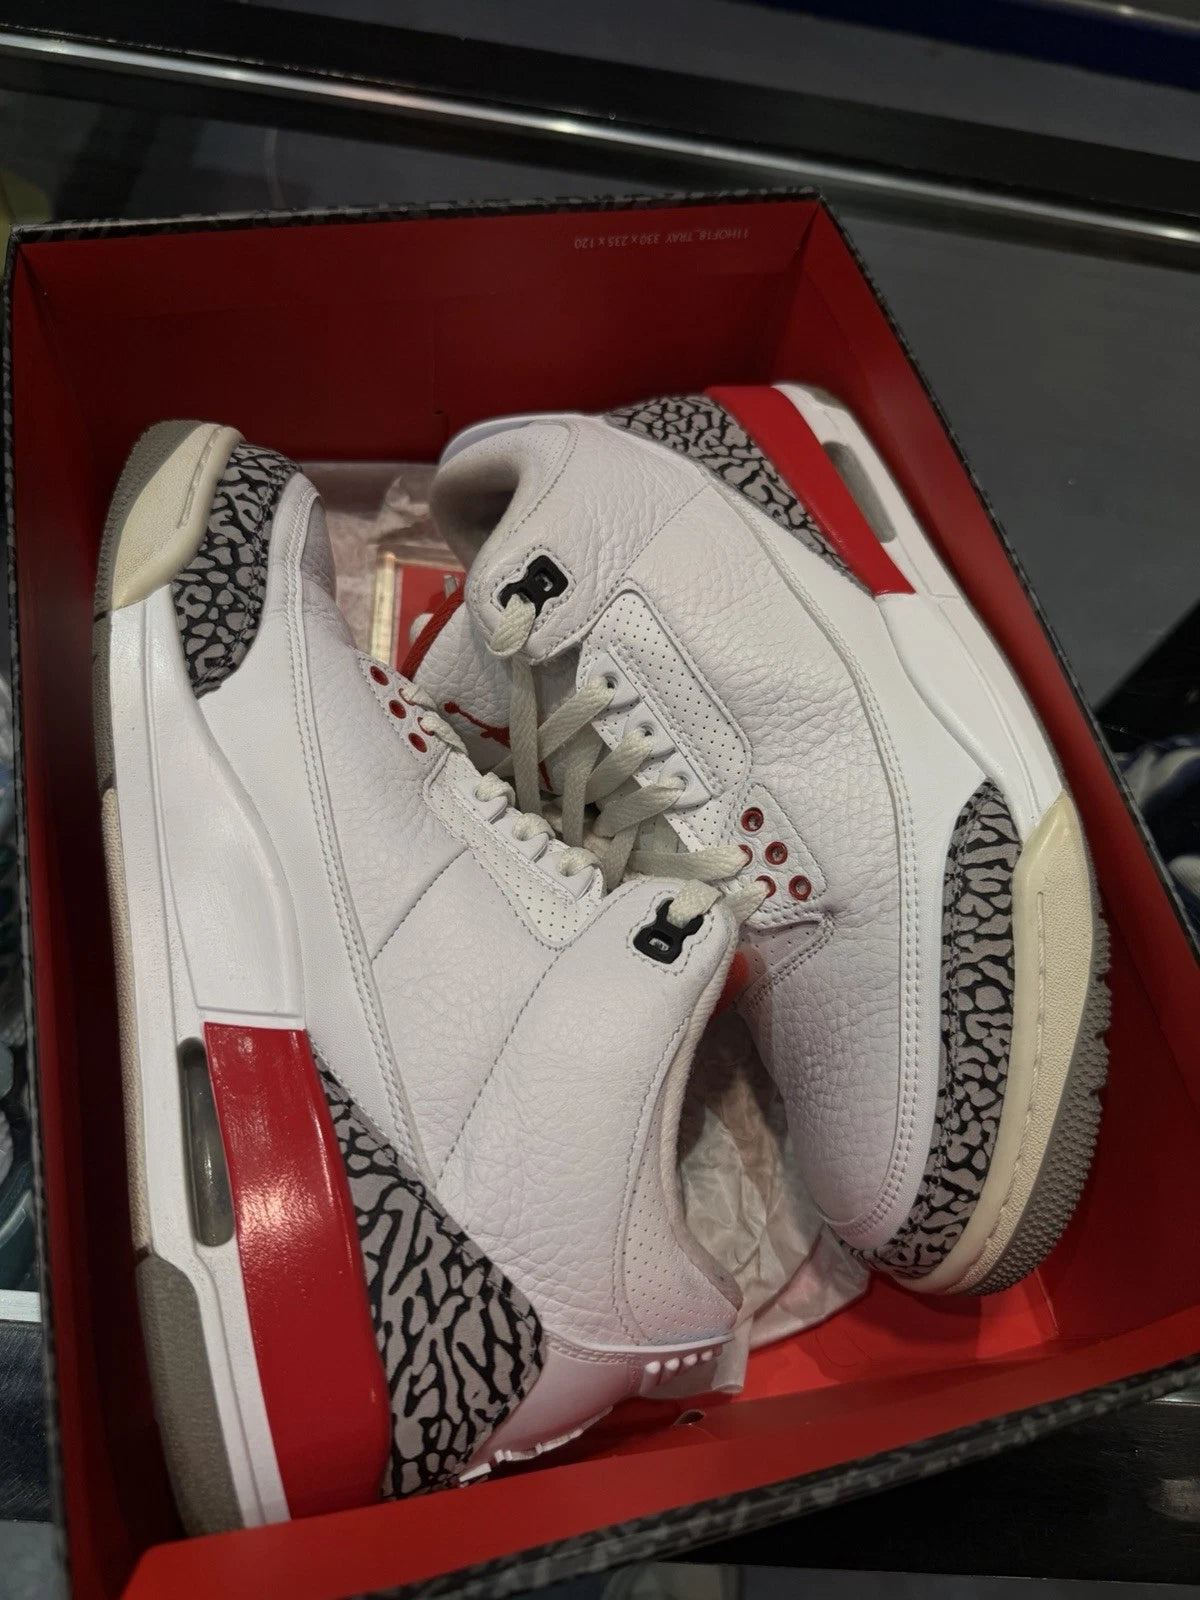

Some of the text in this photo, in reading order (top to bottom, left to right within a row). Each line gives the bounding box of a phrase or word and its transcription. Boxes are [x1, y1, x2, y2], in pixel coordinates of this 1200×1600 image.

[574, 238, 594, 249] 120
[598, 237, 605, 246] x
[608, 236, 629, 247] 235
[631, 235, 638, 244] x
[640, 234, 660, 245] 330
